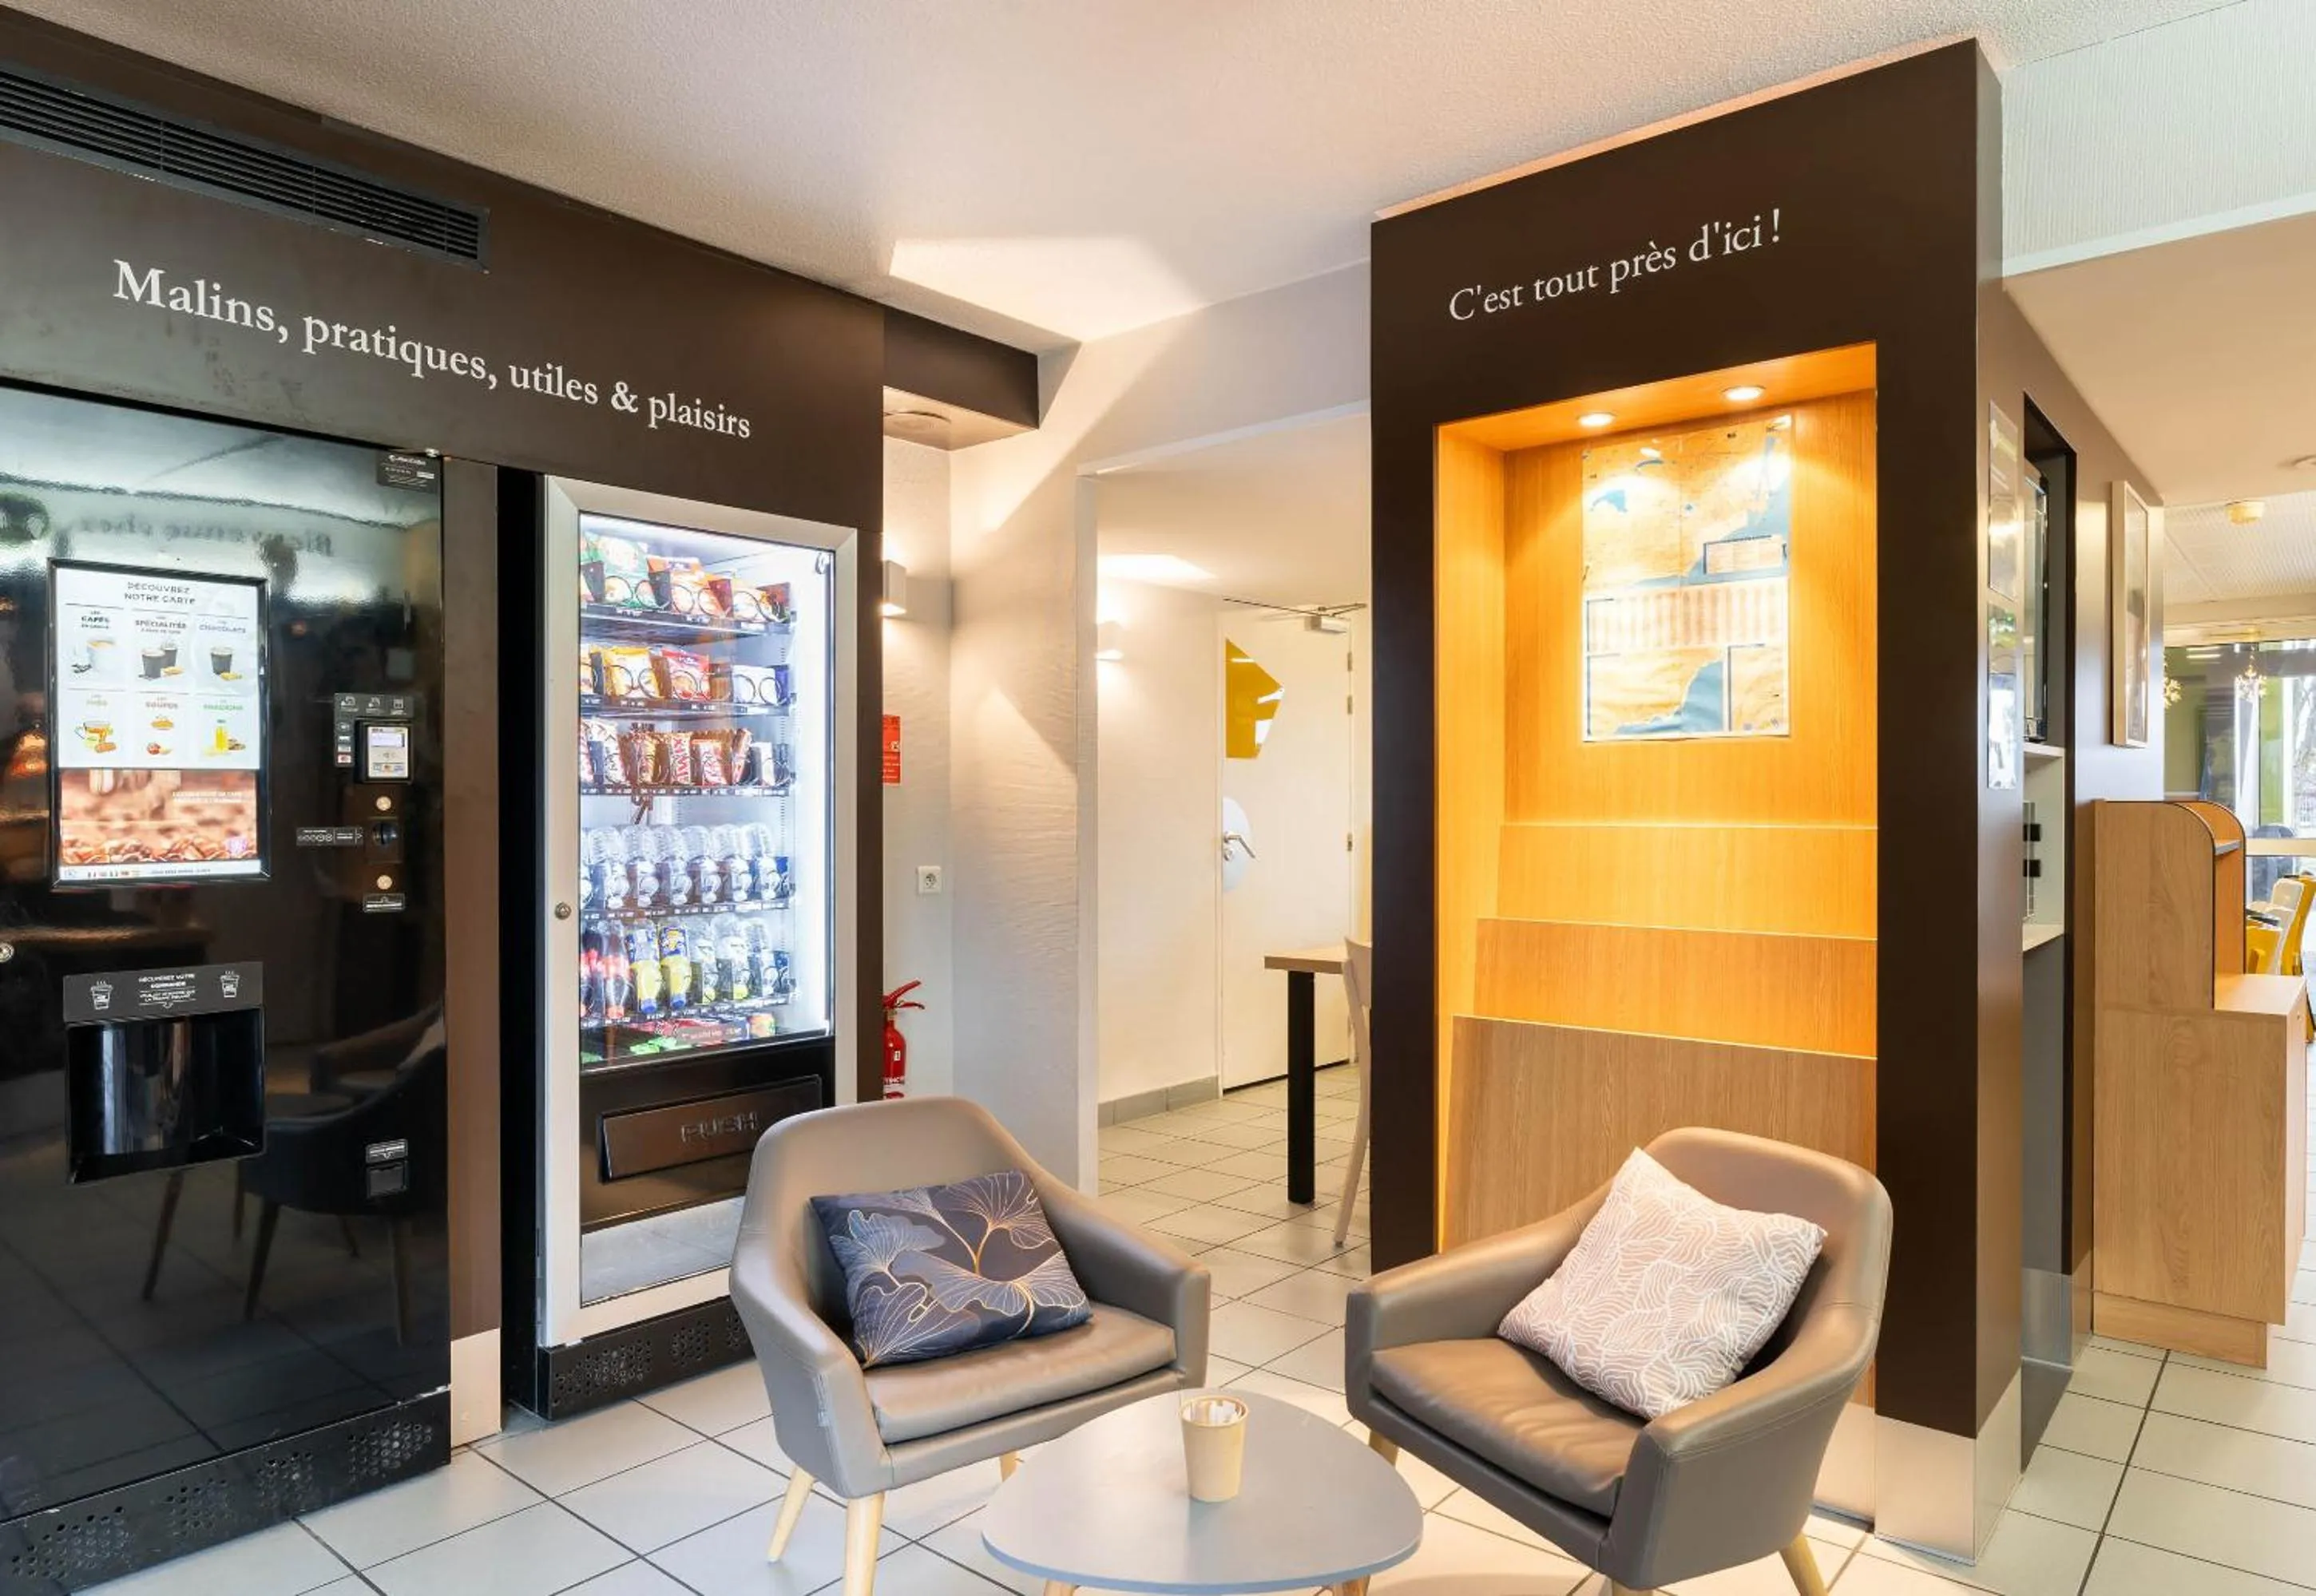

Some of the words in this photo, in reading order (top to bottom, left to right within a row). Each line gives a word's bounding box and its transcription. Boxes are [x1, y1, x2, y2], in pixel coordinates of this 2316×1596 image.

[1449, 284, 1523, 321] C'est
[1533, 265, 1600, 301] tout
[1610, 240, 1677, 294] près
[113, 259, 289, 344] Malins,
[302, 315, 498, 390] pratiques,
[509, 362, 599, 405] utiles
[611, 381, 640, 413] &
[648, 393, 751, 439] plaisirs
[680, 1111, 758, 1143] PUSH
